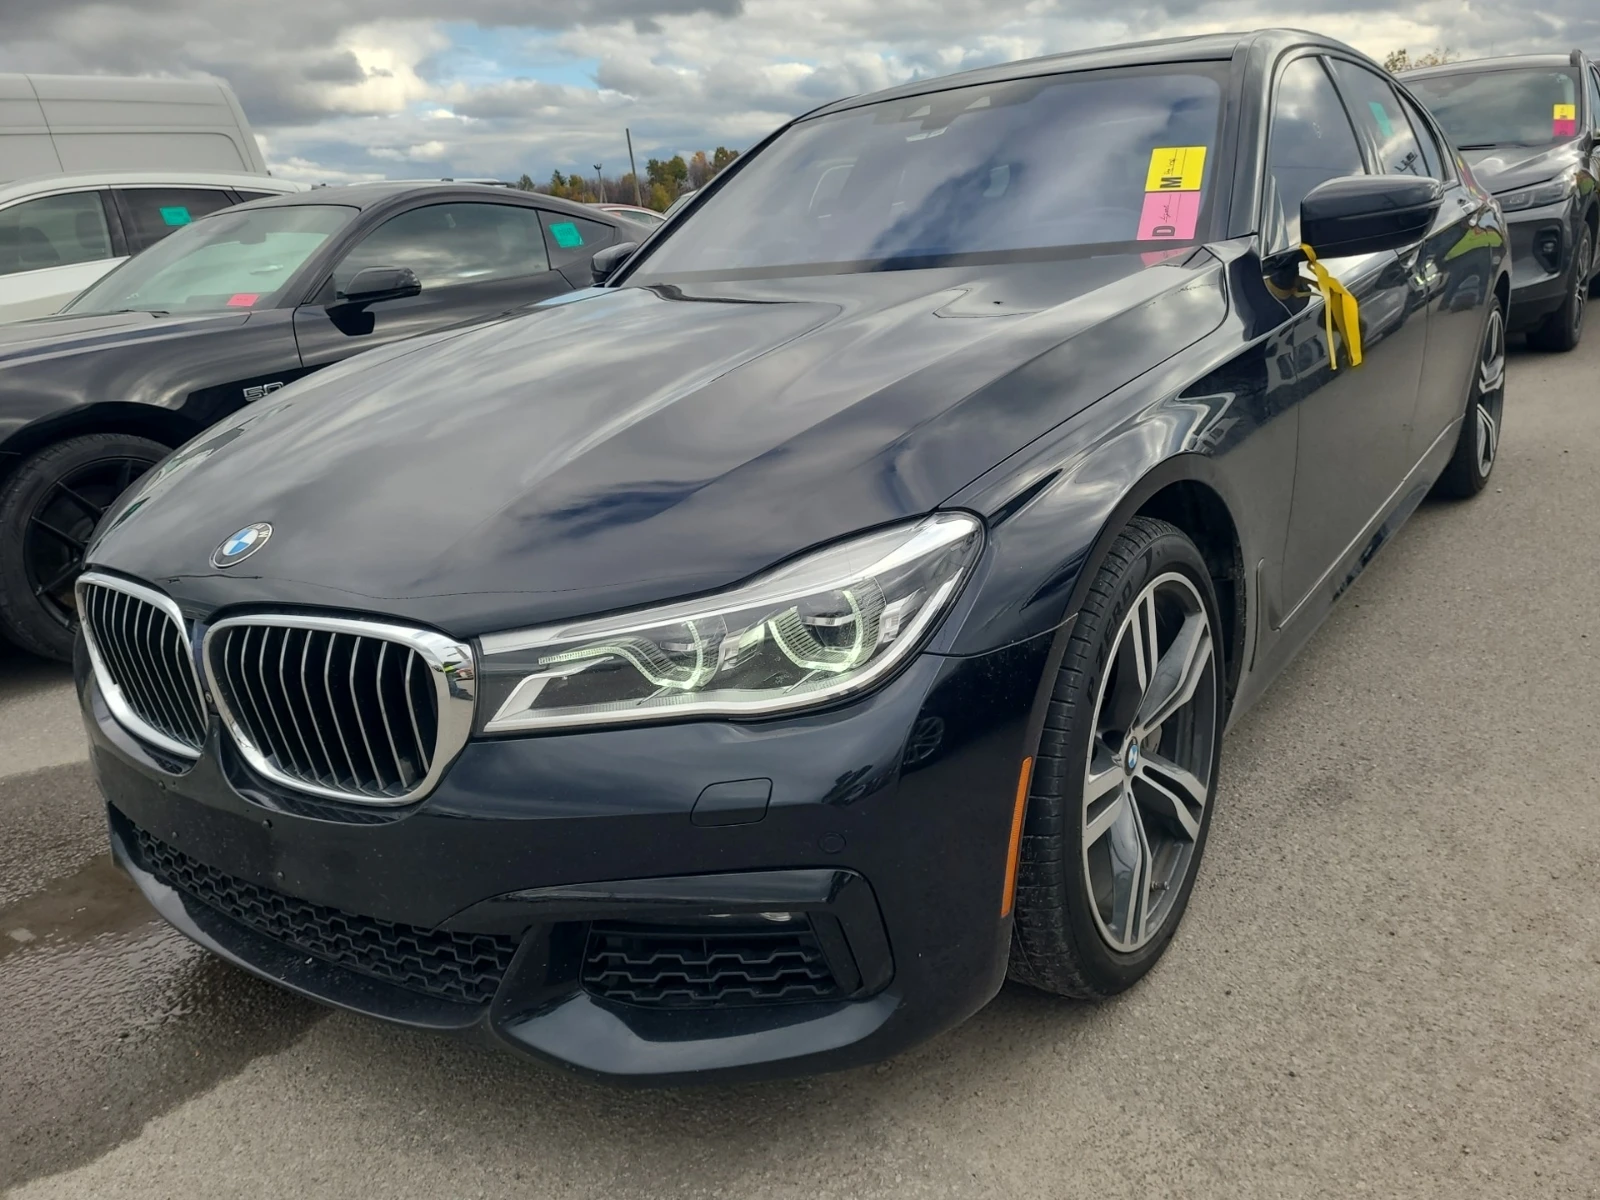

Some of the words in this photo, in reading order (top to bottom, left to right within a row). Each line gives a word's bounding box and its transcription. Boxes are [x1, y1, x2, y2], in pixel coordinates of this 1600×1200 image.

[1160, 177, 1182, 188] M
[1152, 226, 1175, 236] D
[1096, 580, 1132, 672] ZERO
